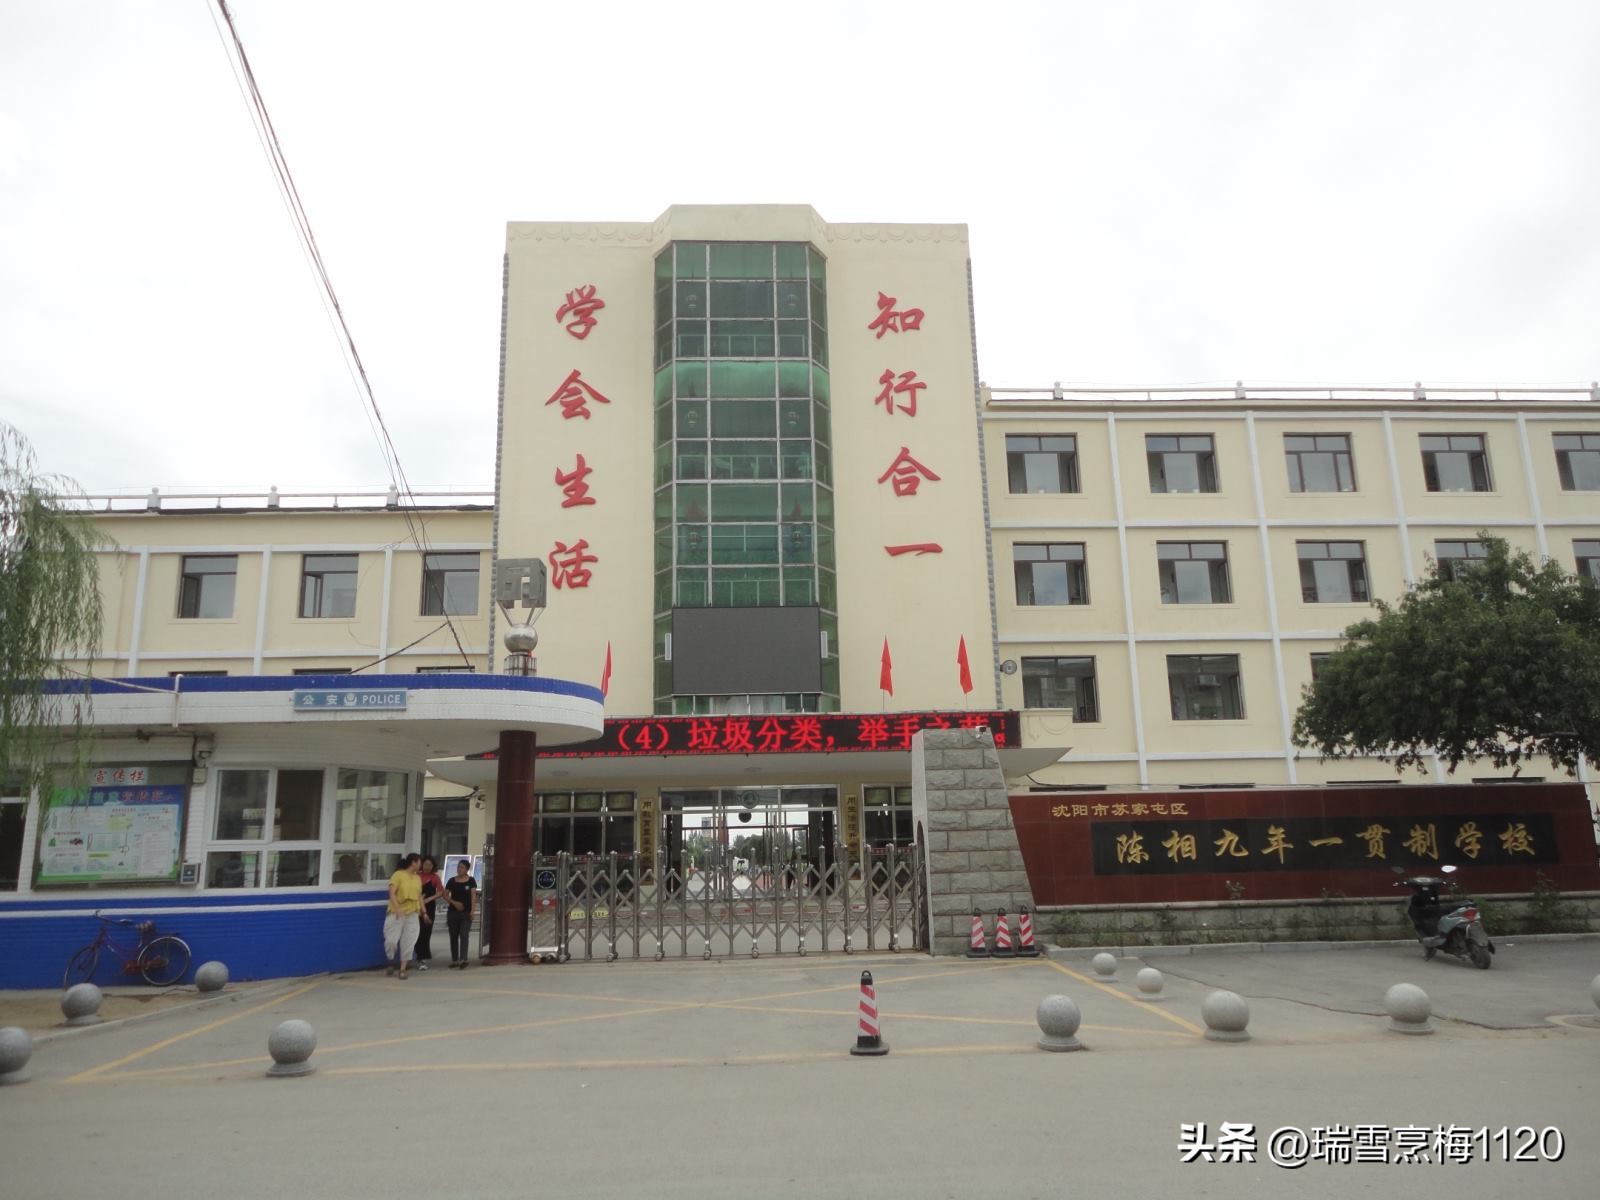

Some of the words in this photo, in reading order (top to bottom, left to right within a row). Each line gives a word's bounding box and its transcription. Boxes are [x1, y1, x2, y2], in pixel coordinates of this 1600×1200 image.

[545, 284, 611, 590] 学会生活
[868, 291, 943, 558] 知行合一
[303, 694, 338, 705] 公安
[362, 694, 401, 704] POLICE
[95, 769, 145, 785] 宣传栏
[1052, 803, 1189, 817] 沈阳市苏家屯区
[1116, 821, 1535, 864] 陈相九年一贯制学校
